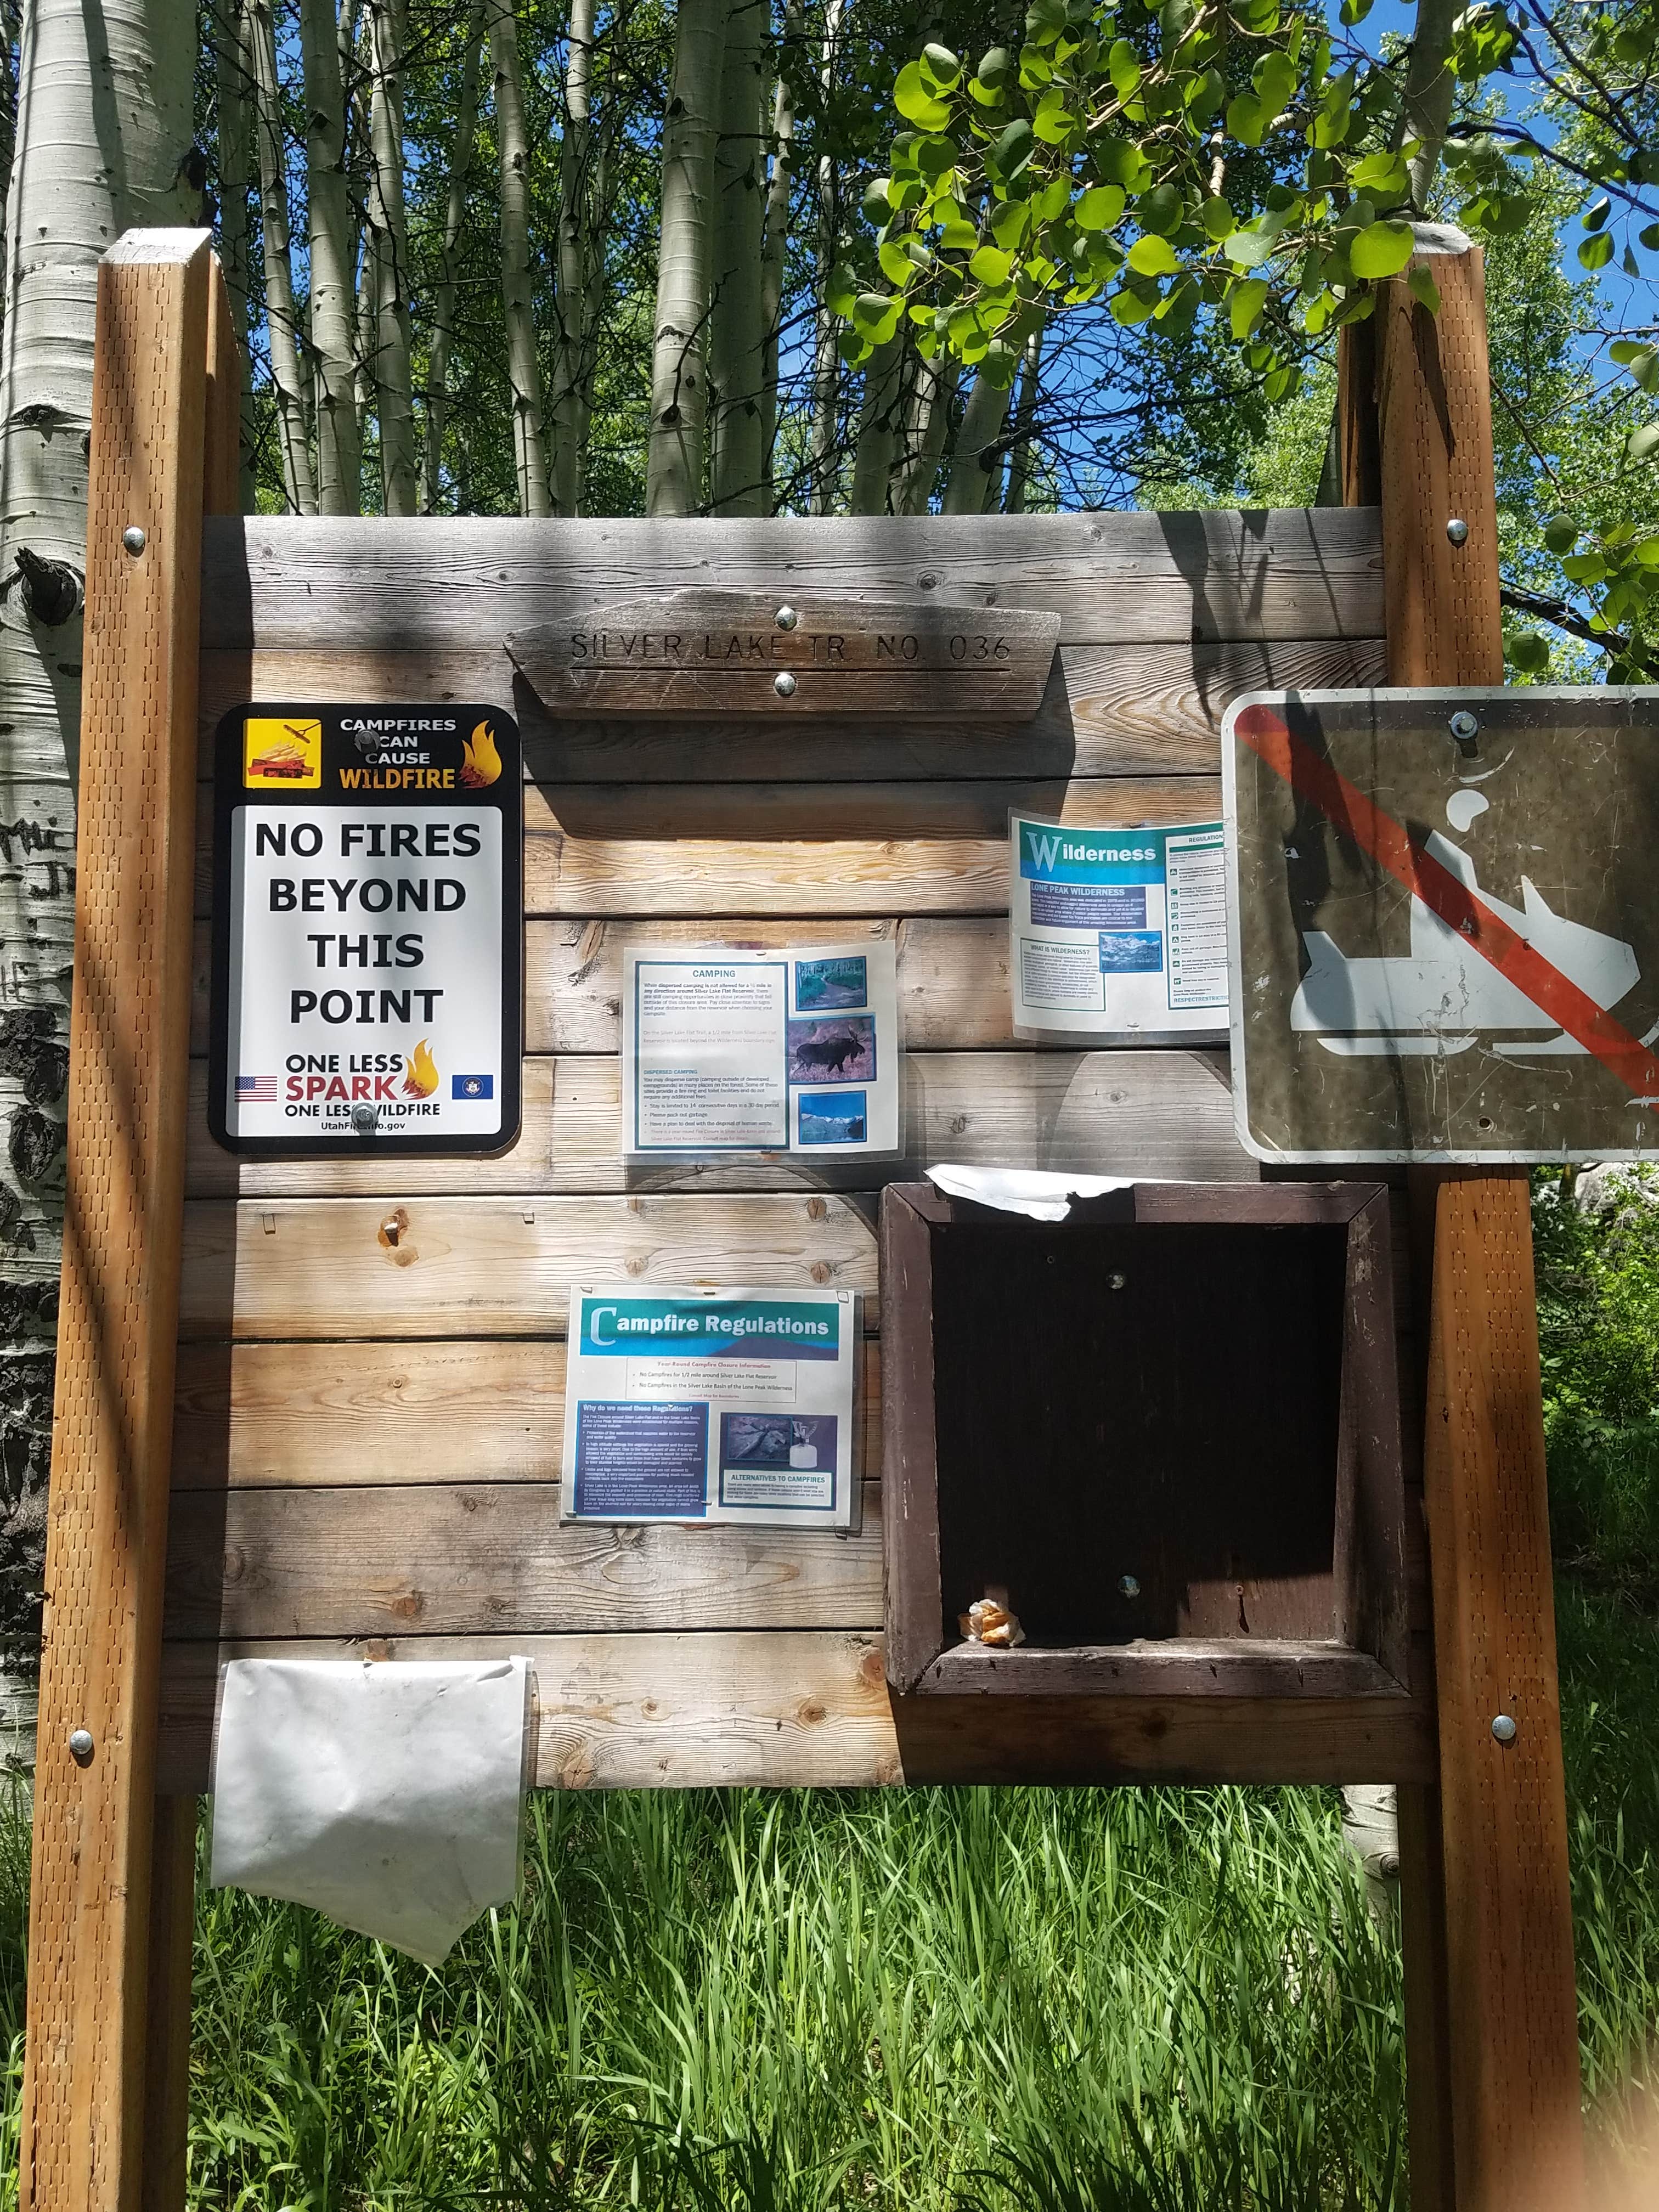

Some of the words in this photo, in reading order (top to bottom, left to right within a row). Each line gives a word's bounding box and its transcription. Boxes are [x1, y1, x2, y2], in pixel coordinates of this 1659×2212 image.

[572, 634, 680, 659] SILVER
[704, 634, 786, 659] LAKE
[950, 635, 1010, 660] 036
[340, 719, 456, 731] CAMPFIRES
[380, 736, 418, 747] CAN
[365, 753, 430, 764] CAUSE
[339, 769, 455, 789] WILDFIRE
[256, 823, 323, 857] NO
[341, 823, 481, 857] FIRES
[1026, 832, 1156, 872] Wilderness
[269, 878, 466, 912] BEYOND
[1031, 883, 1048, 893] LONE
[1049, 885, 1069, 895] PEAK
[1070, 887, 1125, 896] WILDERNESS
[307, 934, 424, 968] THIS
[291, 990, 444, 1024] POINT
[286, 1054, 340, 1073] ONE
[349, 1054, 403, 1073] LESS
[285, 1076, 398, 1101] SPARK
[285, 1104, 320, 1117] ONE
[326, 1104, 358, 1117] LES
[590, 1307, 699, 1346] Campfire
[706, 1314, 830, 1336] Regulations
